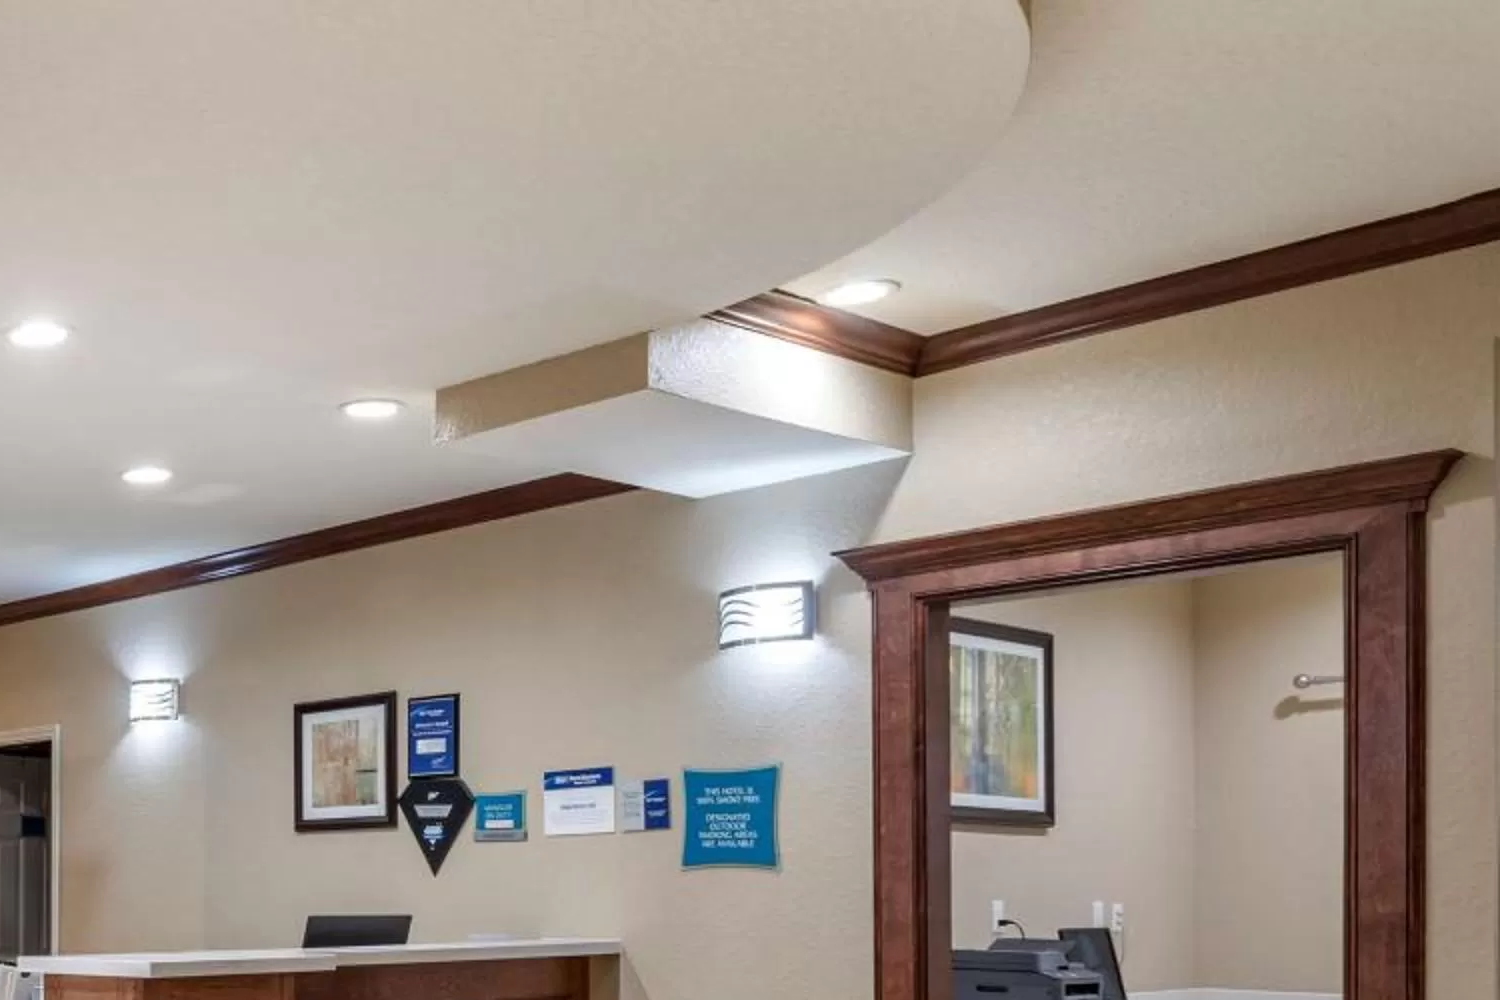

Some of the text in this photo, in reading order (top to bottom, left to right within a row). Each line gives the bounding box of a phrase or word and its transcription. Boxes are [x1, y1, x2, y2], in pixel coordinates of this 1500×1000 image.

[722, 786, 744, 795] HOTEL
[705, 813, 751, 822] DESIGNATED
[709, 822, 747, 831] OUTDOOR
[717, 839, 755, 848] AVAILABLE
